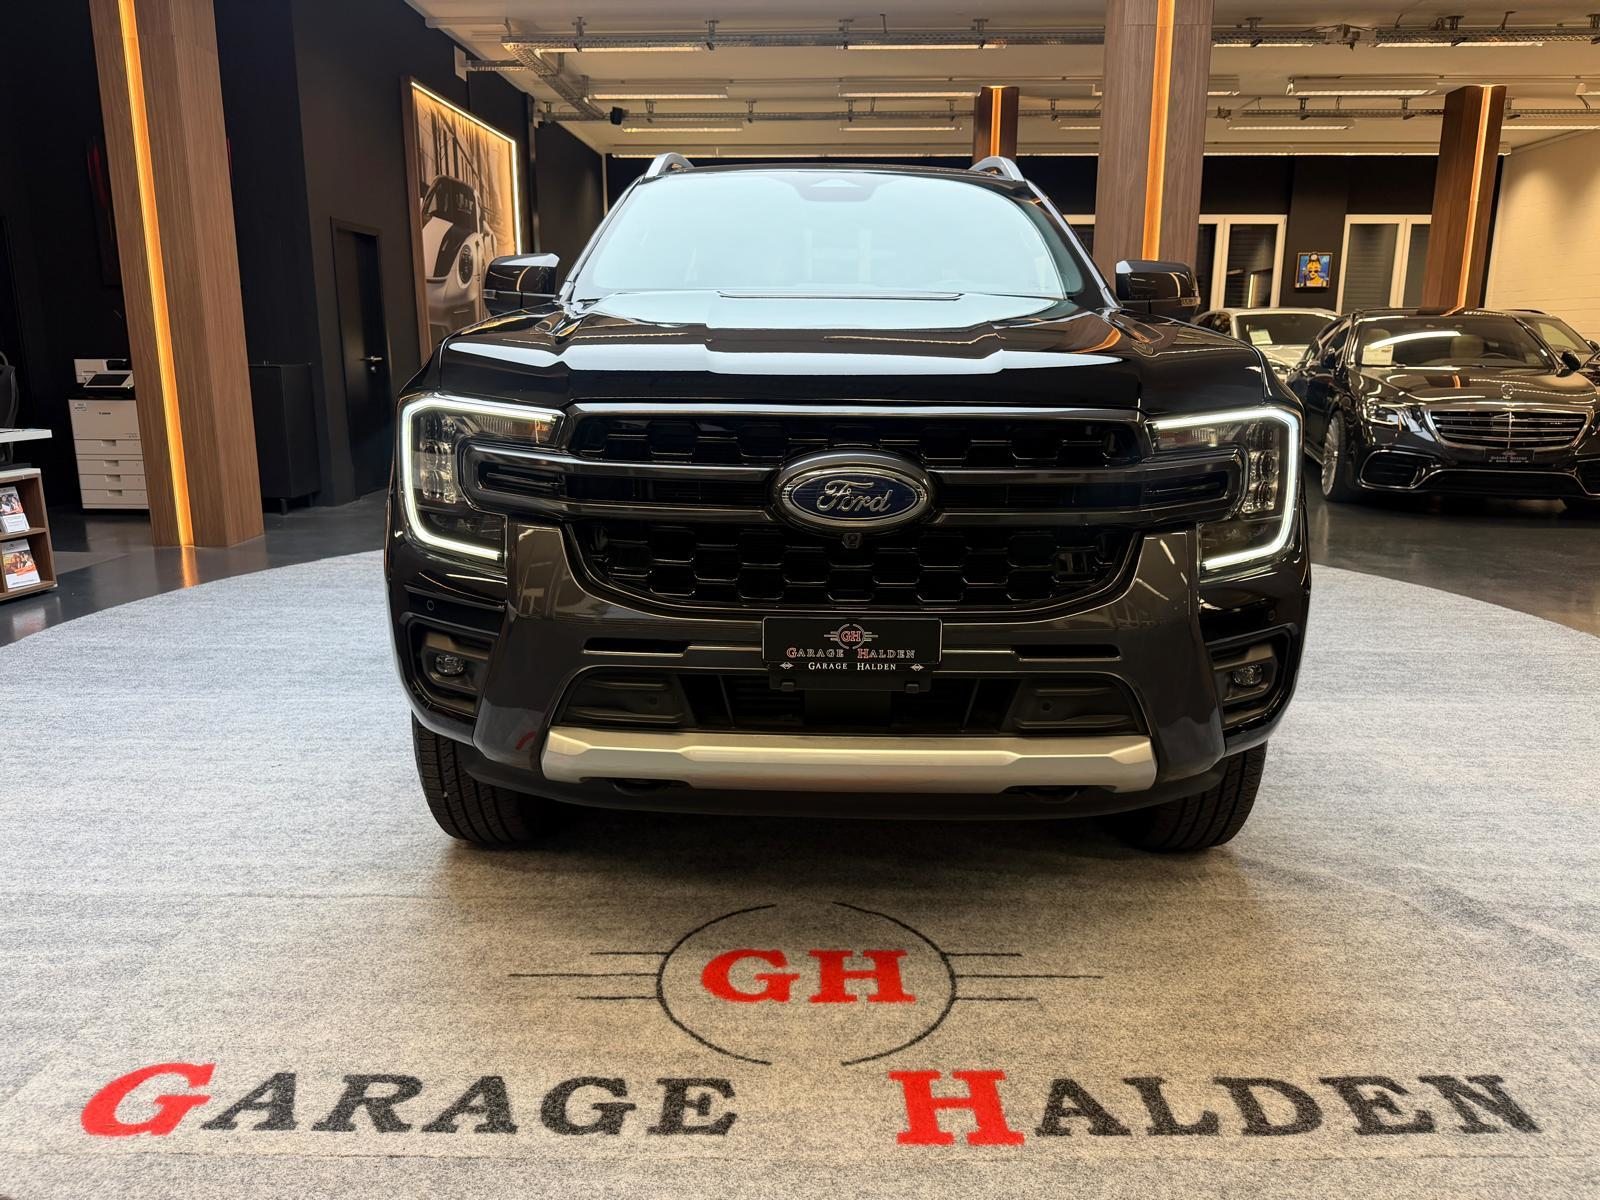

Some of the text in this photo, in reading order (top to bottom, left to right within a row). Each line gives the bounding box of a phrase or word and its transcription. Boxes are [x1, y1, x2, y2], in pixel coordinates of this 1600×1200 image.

[816, 479, 894, 512] Ford
[840, 630, 862, 642] GH
[786, 647, 916, 659] GARAGE HALDEN
[808, 662, 897, 671] GARAGE HALDEN
[699, 948, 916, 1003] GH
[80, 1062, 1541, 1145] GARAGE HALDEN
